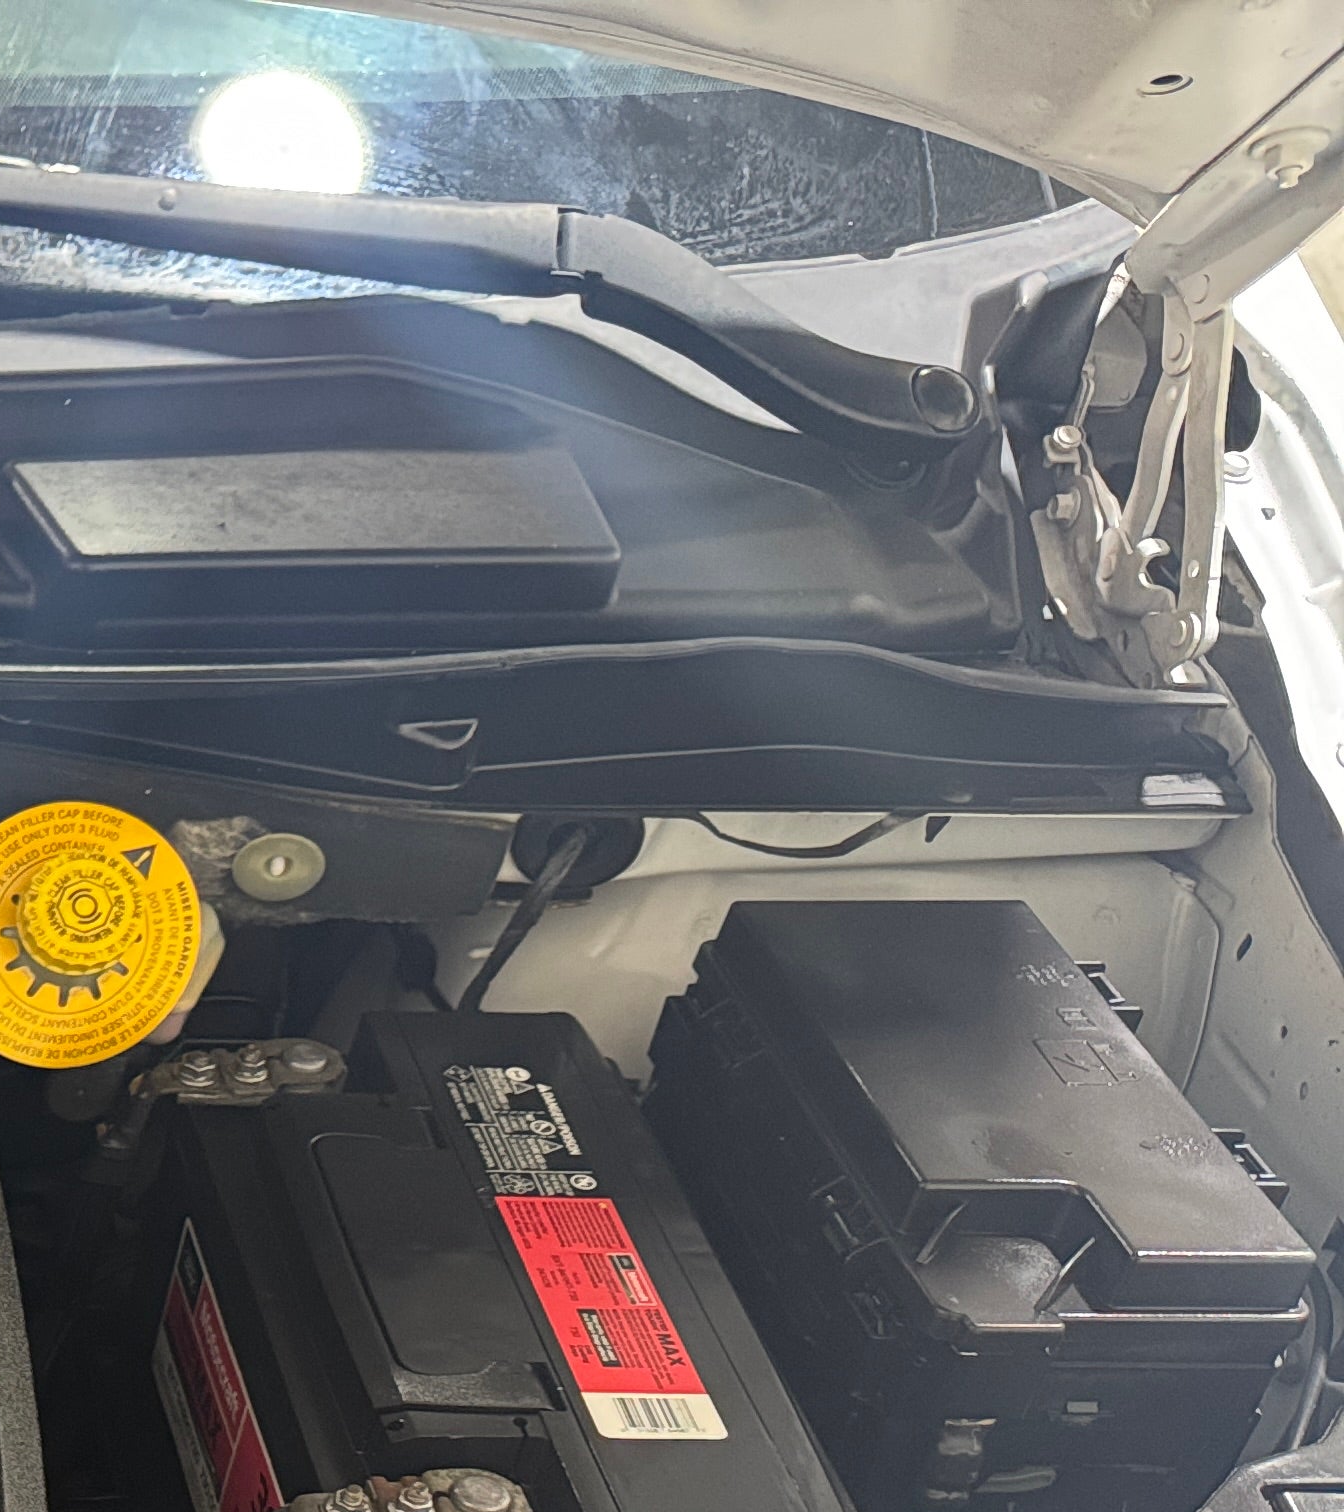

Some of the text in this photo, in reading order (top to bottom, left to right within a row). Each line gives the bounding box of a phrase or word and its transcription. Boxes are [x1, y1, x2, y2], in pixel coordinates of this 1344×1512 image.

[18, 810, 55, 829] FILLER
[57, 809, 79, 819] CAP
[82, 808, 124, 830] BEFORE
[19, 825, 51, 845] ONLY
[52, 822, 76, 835] DOT
[78, 822, 86, 834] 3
[87, 822, 121, 844] FLUID
[1, 847, 41, 879] SEALED
[145, 891, 163, 914] DOT
[160, 885, 180, 921] AVANT
[175, 880, 193, 912] MISE
[152, 916, 165, 925] 3
[168, 925, 179, 939] DE
[182, 914, 194, 932] EN
[165, 942, 177, 957] LE
[172, 935, 192, 980] GARDE
[131, 927, 164, 997] PROVENANT
[130, 984, 177, 1035] NETTOYER
[63, 1036, 119, 1058] BOUCHON
[116, 1028, 134, 1044] LE
[44, 1048, 60, 1060] DE
[656, 1333, 687, 1367] MAX
